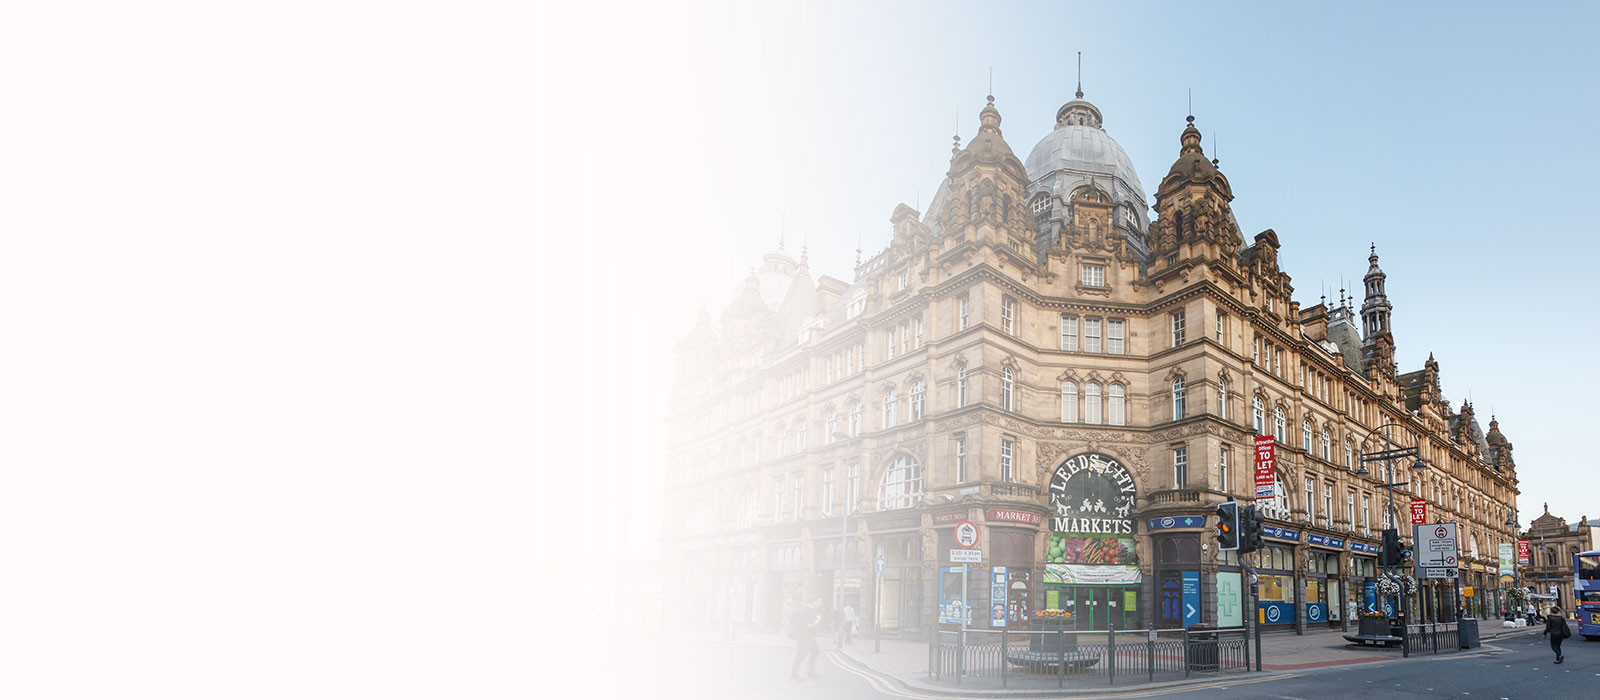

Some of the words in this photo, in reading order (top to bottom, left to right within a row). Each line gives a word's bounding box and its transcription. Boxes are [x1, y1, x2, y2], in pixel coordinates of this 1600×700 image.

[1259, 452, 1270, 460] TO
[1257, 461, 1272, 470] LET
[1050, 454, 1099, 492] LEEDS
[1106, 460, 1136, 493] CITY
[996, 511, 1030, 522] MARKET
[1054, 517, 1132, 534] MARKETS
